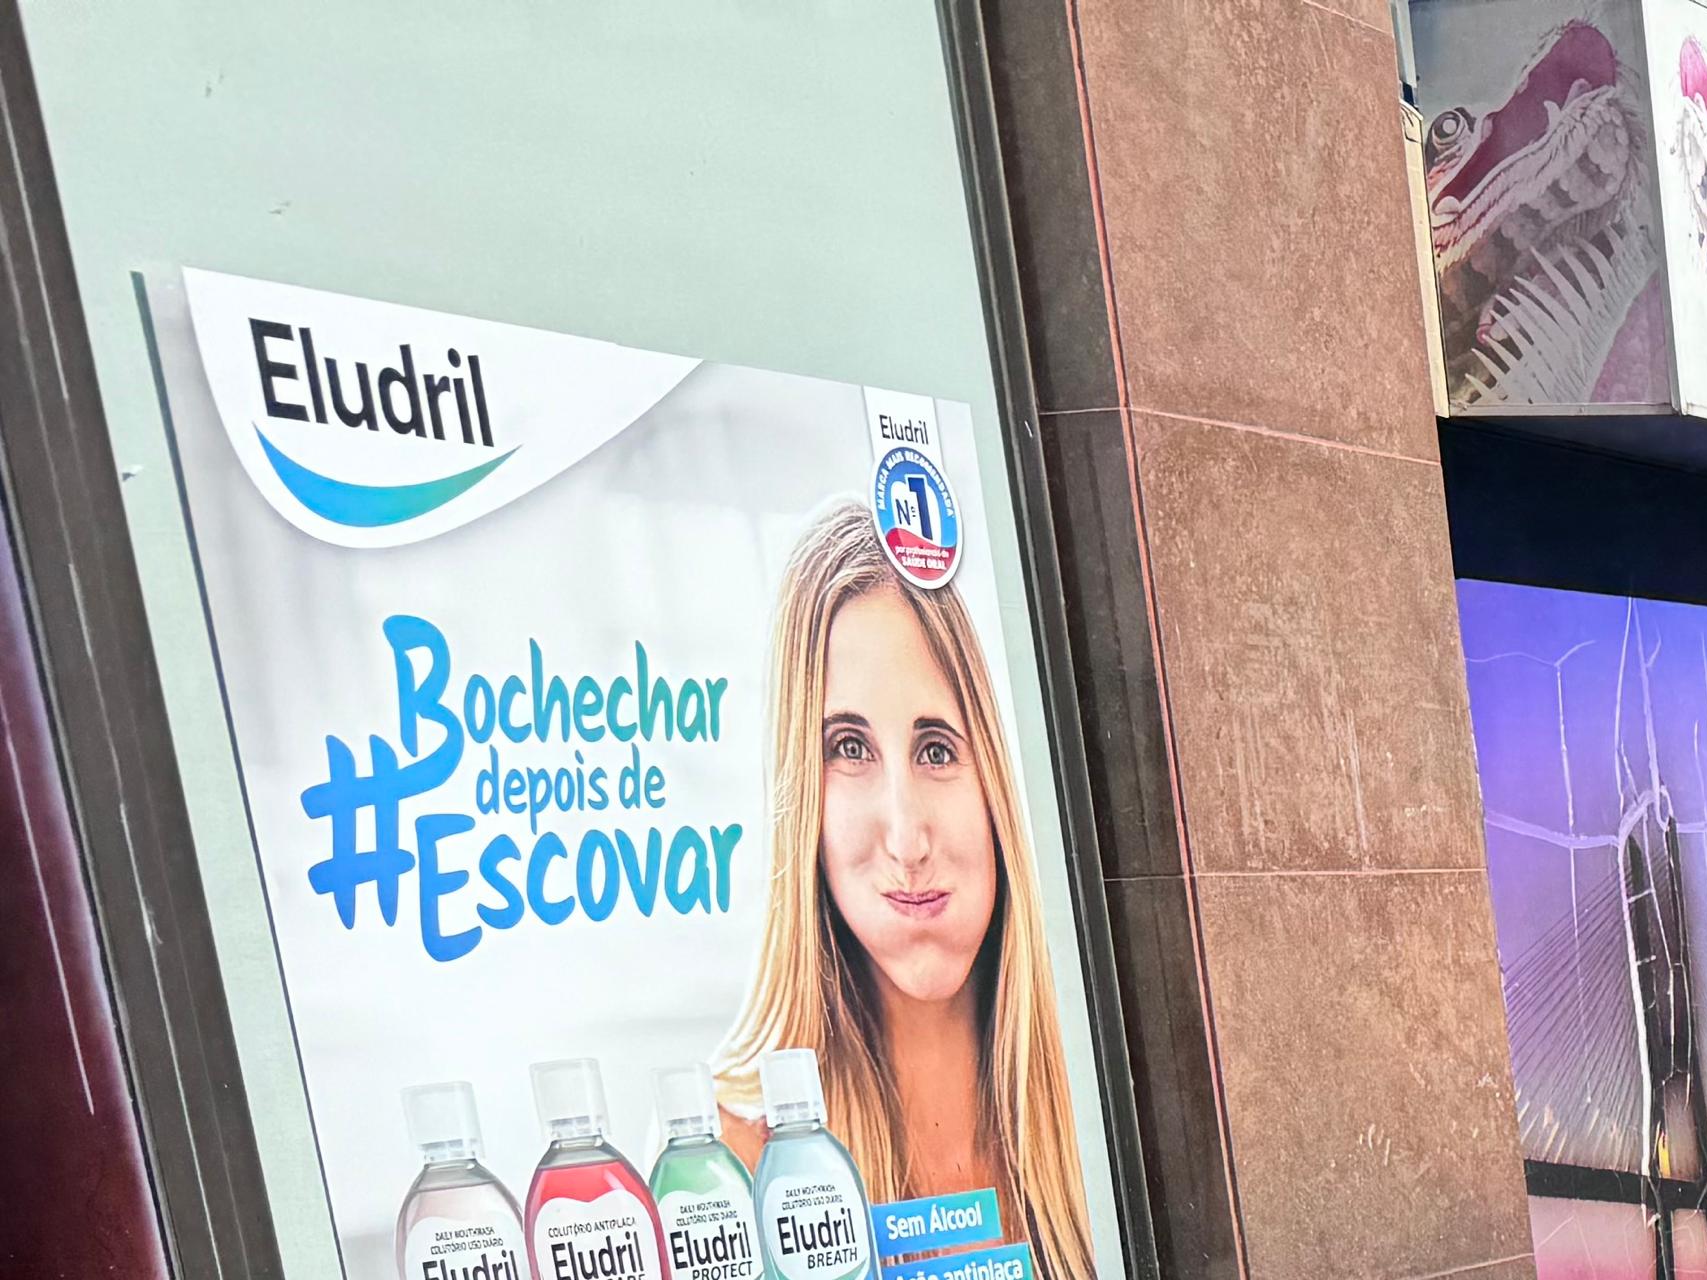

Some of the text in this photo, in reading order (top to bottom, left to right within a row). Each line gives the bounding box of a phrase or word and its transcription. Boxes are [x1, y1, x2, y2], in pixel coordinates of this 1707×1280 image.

[249, 318, 494, 446] Eludril
[879, 414, 929, 445] Eludril
[907, 476, 933, 541] 1
[382, 615, 728, 775] Bochechar
[476, 743, 665, 835] depois de
[777, 1207, 856, 1255] Eludril
[886, 1201, 983, 1240] Sem Álcool
[670, 1221, 751, 1270] Eludril
[808, 1247, 858, 1269] BREATH
